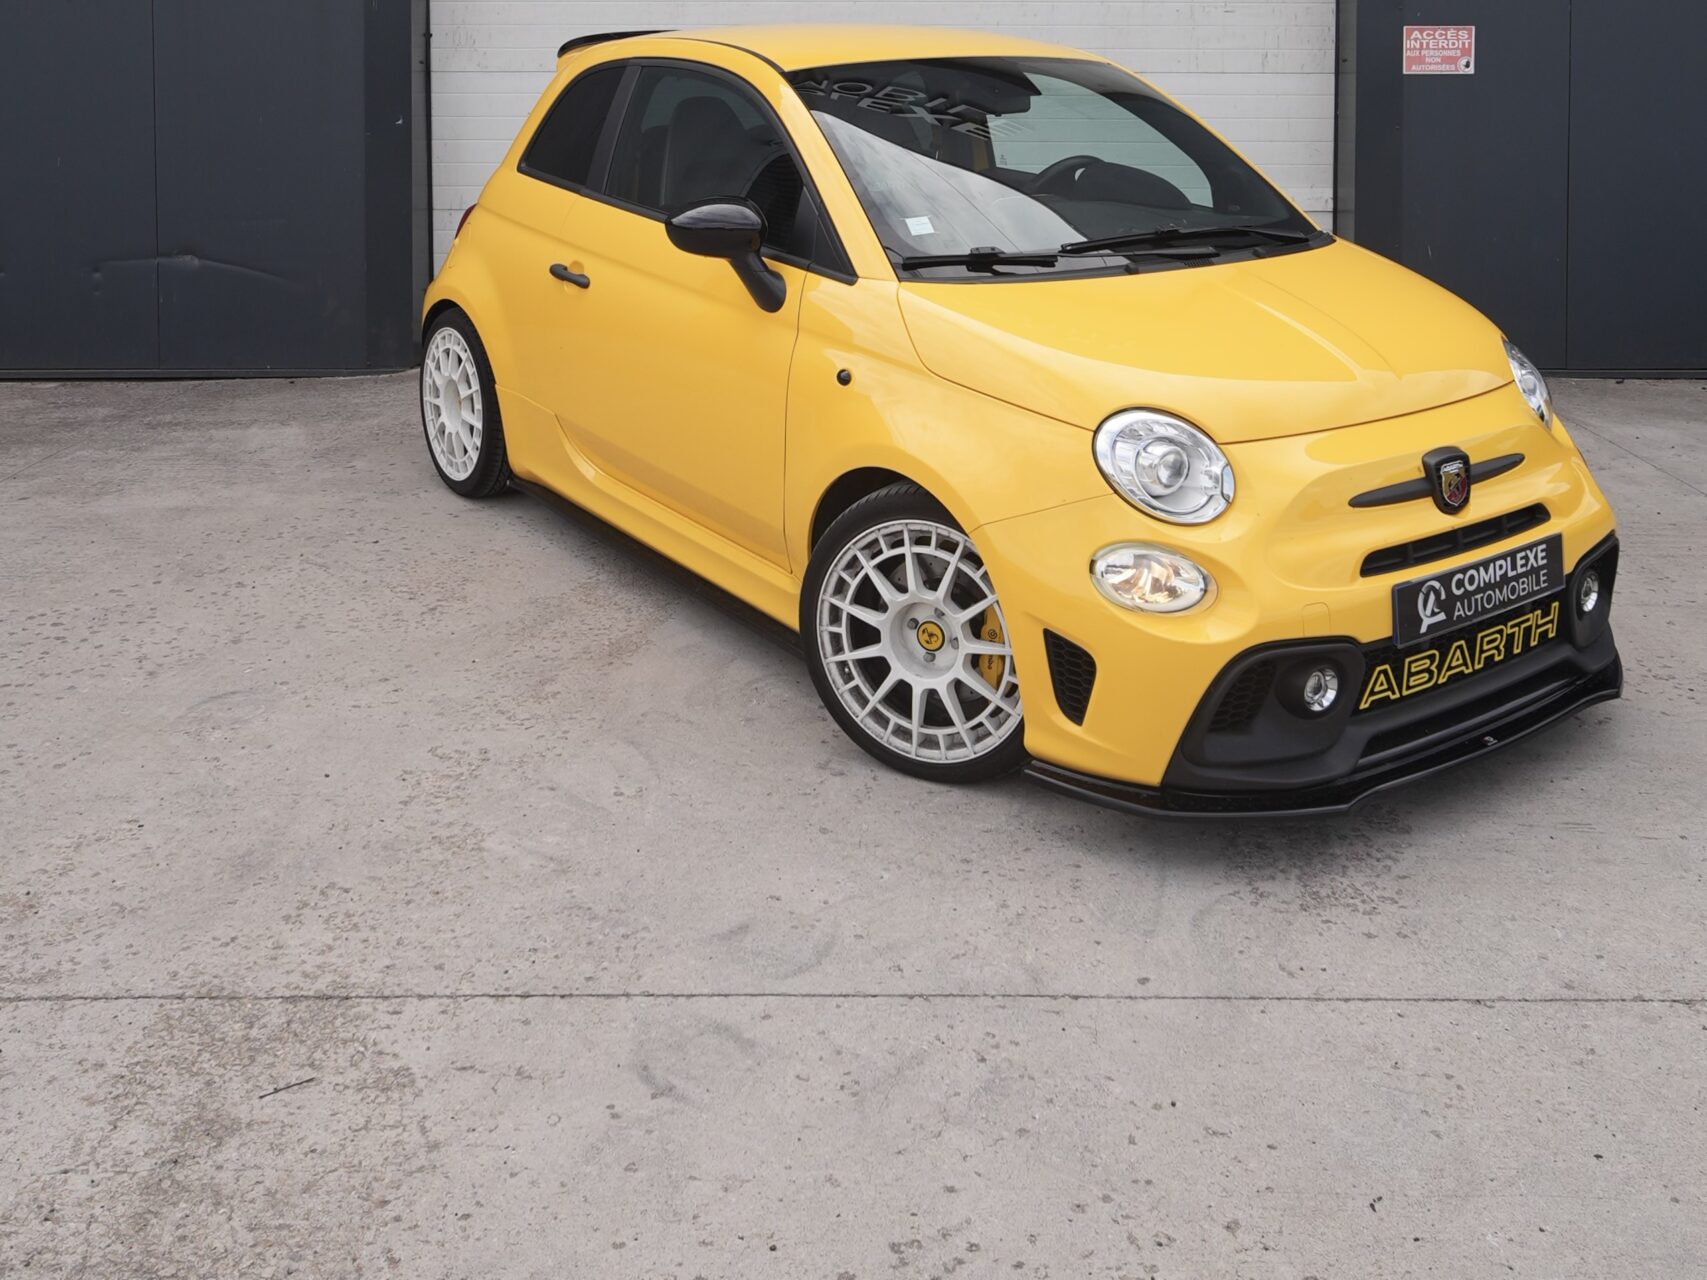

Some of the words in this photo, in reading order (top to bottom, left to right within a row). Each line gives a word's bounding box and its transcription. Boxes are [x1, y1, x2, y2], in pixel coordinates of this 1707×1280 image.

[1406, 39, 1471, 49] INTERDIT
[1410, 28, 1469, 40] ACCÈS
[1422, 49, 1462, 57] PERSONNES
[1451, 543, 1547, 596] COMPLEXE
[1453, 569, 1548, 621] AUTOMOBILE
[1359, 601, 1559, 710] ABARTH
